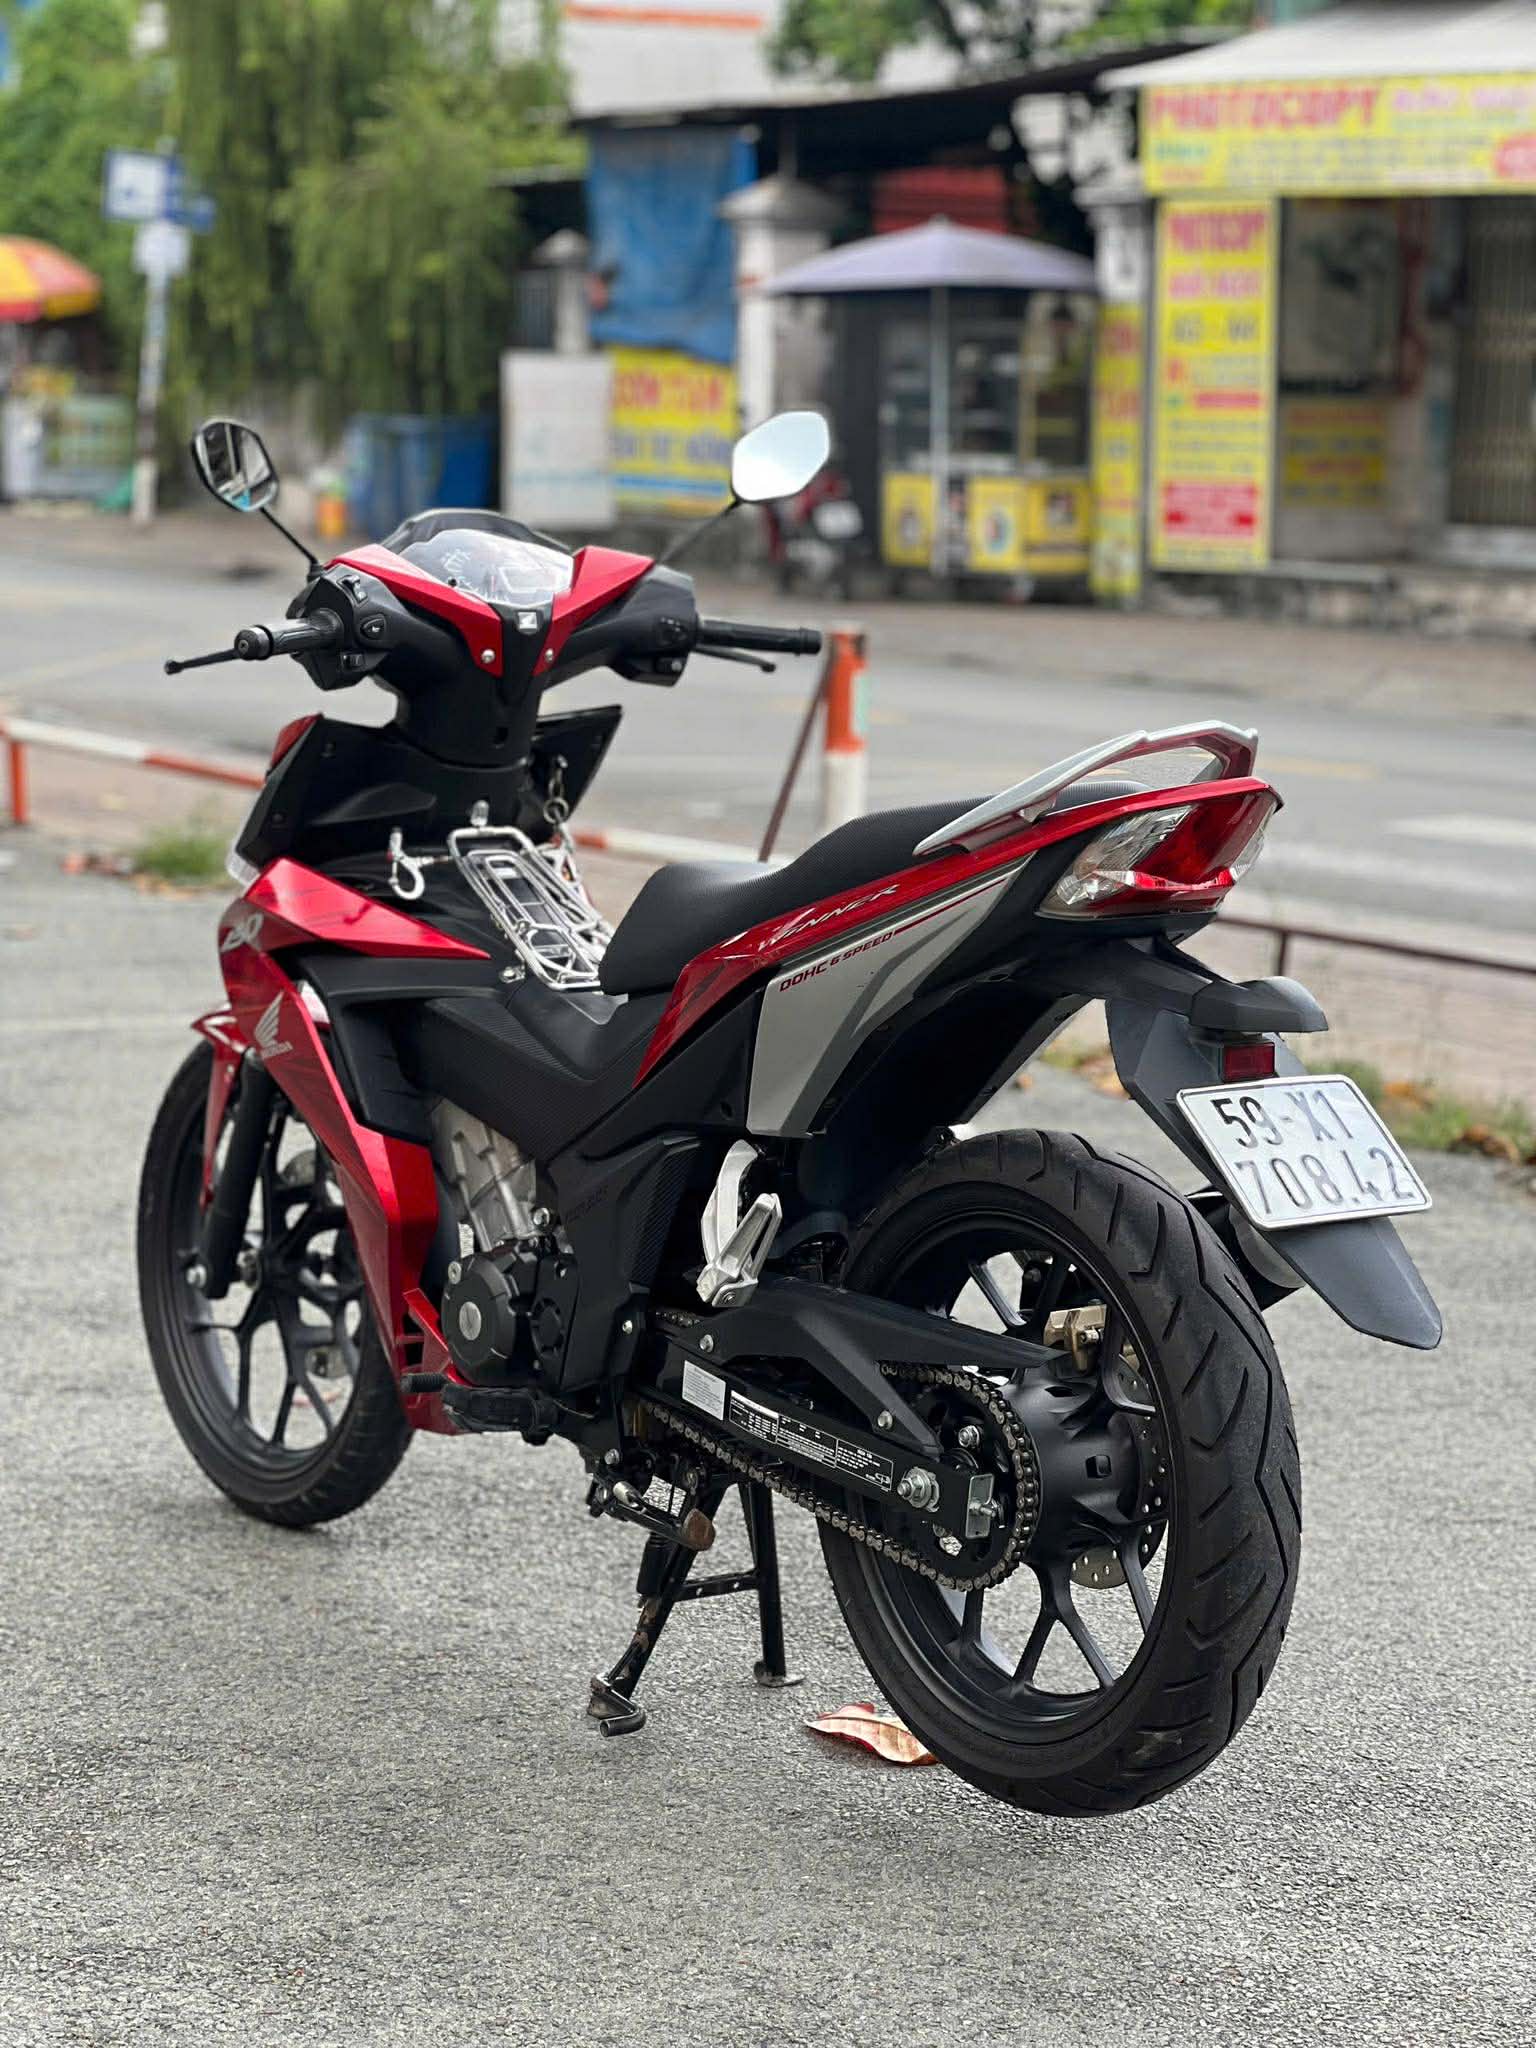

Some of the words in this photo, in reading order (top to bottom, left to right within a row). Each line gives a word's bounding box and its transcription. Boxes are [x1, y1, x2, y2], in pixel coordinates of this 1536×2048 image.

[1153, 89, 1379, 131] PHOTOCOPY
[779, 961, 828, 992] DOHC
[842, 931, 893, 961] SPEED
[1209, 1090, 1353, 1149] 59-X1
[1233, 1147, 1414, 1215] 708.42
